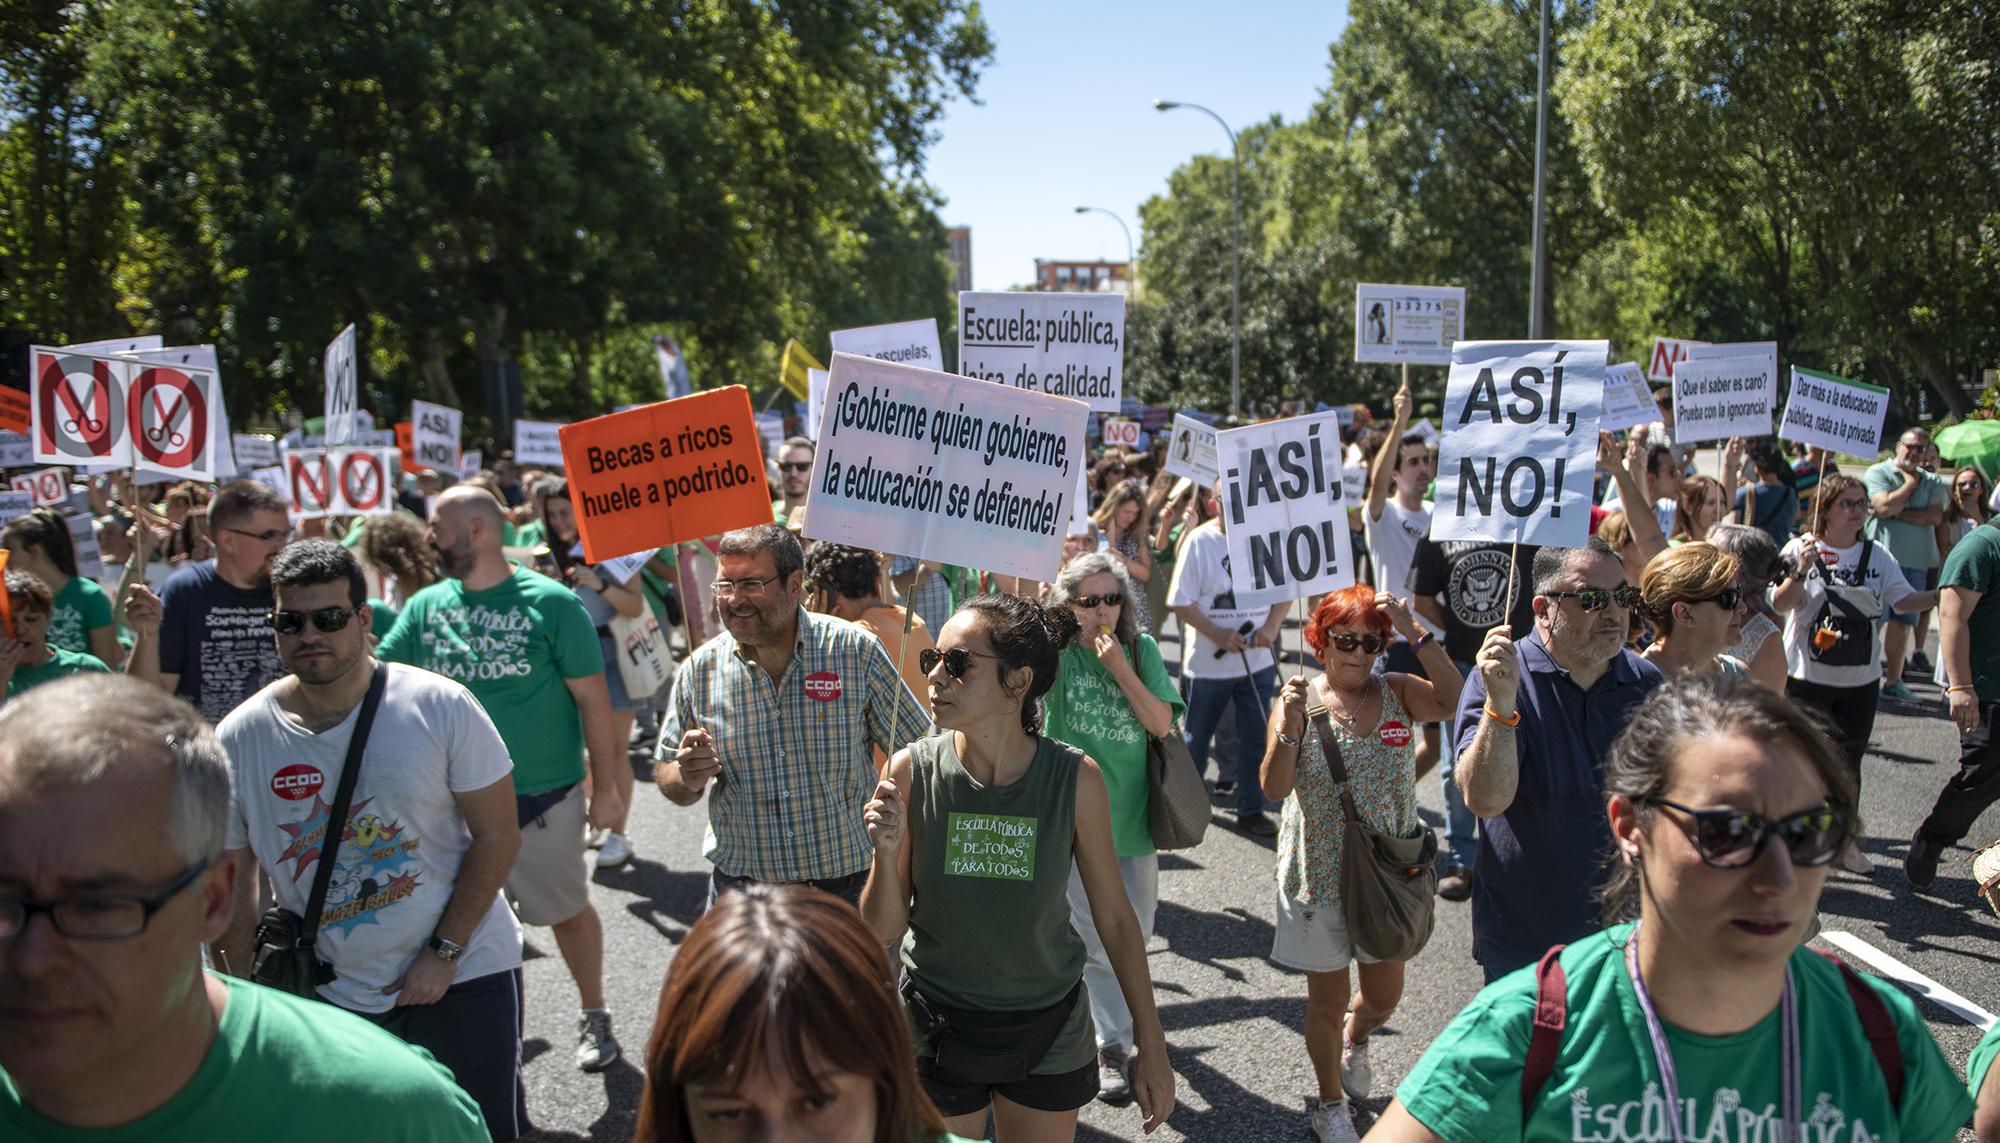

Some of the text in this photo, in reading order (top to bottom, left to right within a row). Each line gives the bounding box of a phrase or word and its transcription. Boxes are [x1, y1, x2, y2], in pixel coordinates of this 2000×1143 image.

[963, 307, 1119, 352] Escuela: pública,
[875, 343, 932, 362] escuelas,
[1651, 341, 1688, 377] N
[1015, 363, 1038, 390] de
[1043, 364, 1116, 398] calidad.
[1458, 351, 1577, 436] ASÍ,
[1699, 375, 1708, 394] el
[1708, 375, 1731, 394] saber
[1733, 379, 1743, 392] es
[1744, 372, 1768, 391] caro?
[1796, 376, 1878, 416] Dar más a la educación
[37, 353, 208, 469] NO
[1704, 405, 1717, 420] con
[1718, 401, 1726, 418] la
[1727, 397, 1768, 422] ignorancia!
[1784, 404, 1876, 446] pública, nada a la privada.
[831, 381, 1070, 478] ¡Gobierne quien gobierne,
[1106, 423, 1137, 443] NO
[587, 441, 655, 474] Becas
[660, 437, 673, 459] a
[677, 424, 733, 455] ricos
[581, 459, 757, 517] huele a podrido.
[1227, 422, 1343, 525] ¡ASÍ,
[1456, 457, 1566, 519] NO!
[821, 449, 1063, 536] la educación se defiende!
[1249, 521, 1339, 590] NO!
[1459, 552, 1507, 572] JOHNNY
[805, 680, 842, 690] CCOO
[1380, 728, 1410, 739] CCOO
[273, 772, 322, 789] CCOO
[956, 818, 1033, 837] ESCUELA PÚBLICA
[963, 842, 980, 854] DE
[953, 861, 985, 875] PARA
